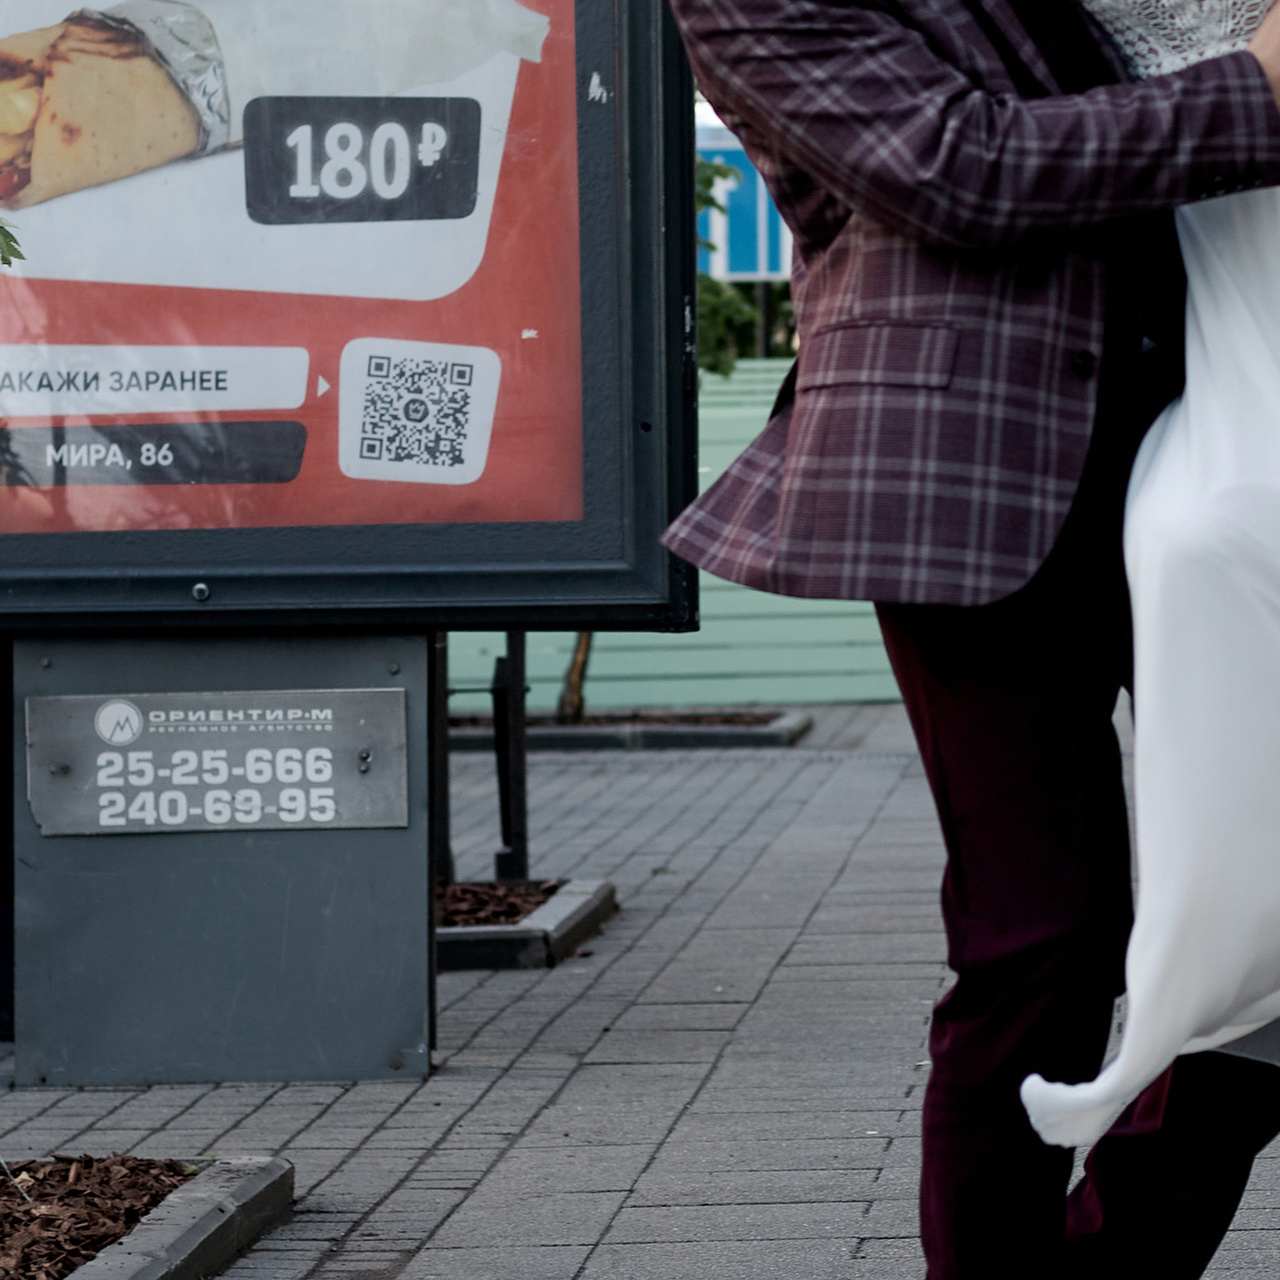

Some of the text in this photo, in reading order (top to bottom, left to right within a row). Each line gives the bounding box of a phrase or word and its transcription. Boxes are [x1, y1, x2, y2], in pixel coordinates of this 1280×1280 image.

[109, 369, 229, 392] ЗАРАНЕЕ
[45, 442, 174, 471] МИРА, 86
[96, 747, 334, 787] 25-25-666
[98, 787, 336, 826] 240-69-95
